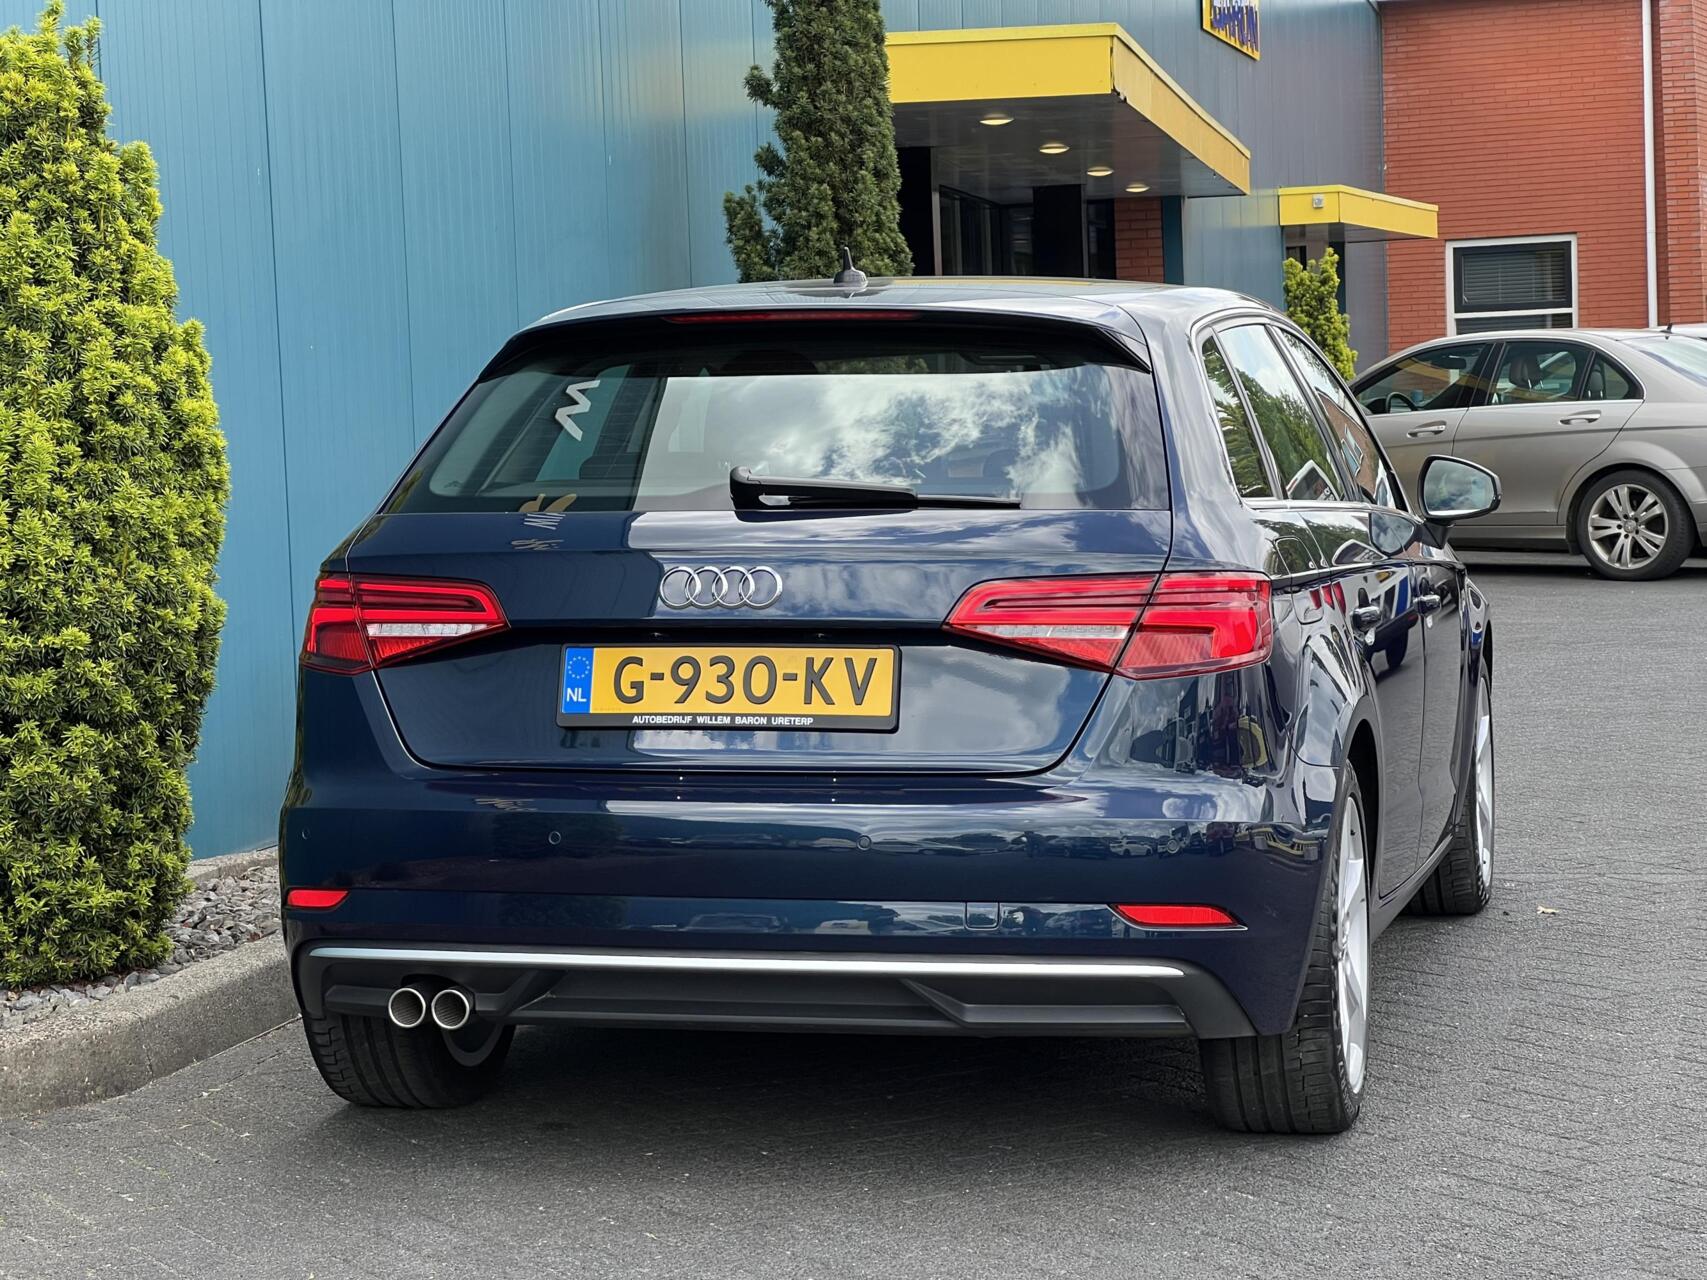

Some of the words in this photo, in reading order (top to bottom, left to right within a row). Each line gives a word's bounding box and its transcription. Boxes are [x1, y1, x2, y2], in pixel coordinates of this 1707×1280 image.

[613, 655, 878, 706] G-930-KV
[566, 687, 587, 702] NL
[632, 715, 693, 724] AUTOBEDRIJF
[696, 715, 731, 725] WILLEM
[735, 716, 767, 725] BARON
[771, 717, 814, 726] URETERP
